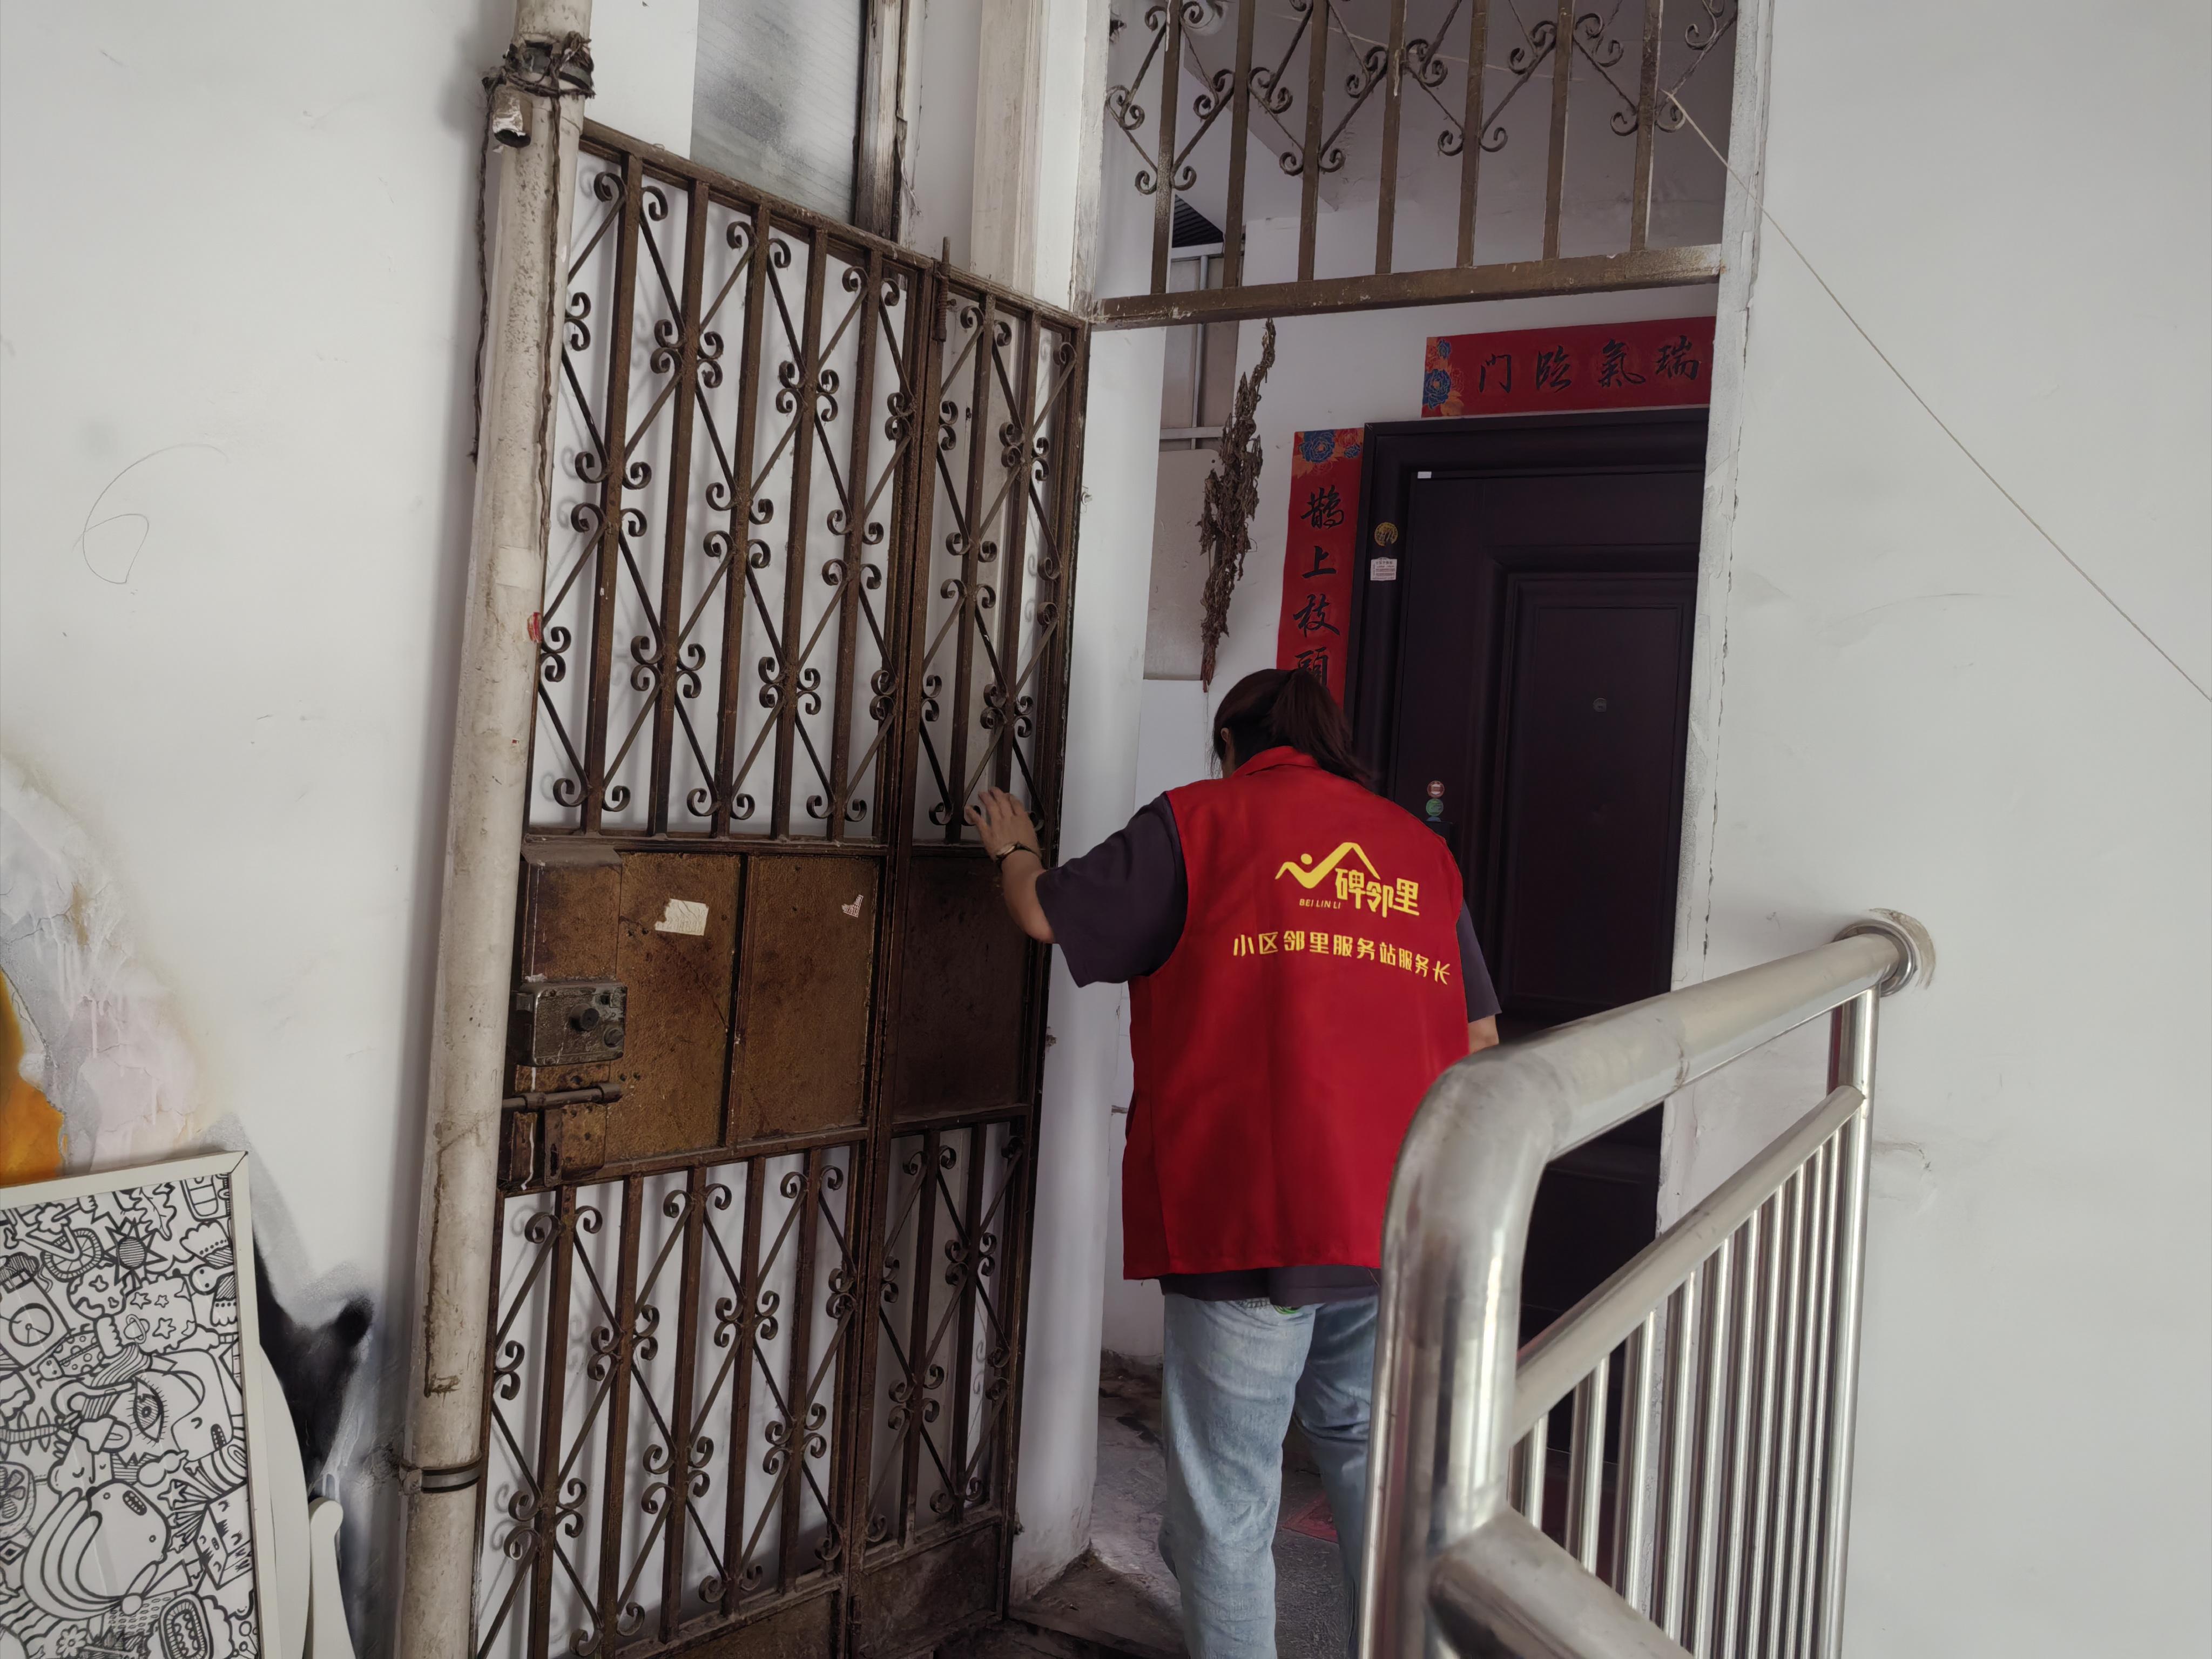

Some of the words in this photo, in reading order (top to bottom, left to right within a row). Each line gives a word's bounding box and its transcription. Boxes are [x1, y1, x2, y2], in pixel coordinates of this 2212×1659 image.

[1299, 898, 1314, 907] BEI
[1316, 899, 1331, 908] LIN
[1333, 901, 1341, 909] LI
[1335, 867, 1420, 918] 碑邻里
[1233, 930, 1451, 985] 小区邻里服务站服务长
